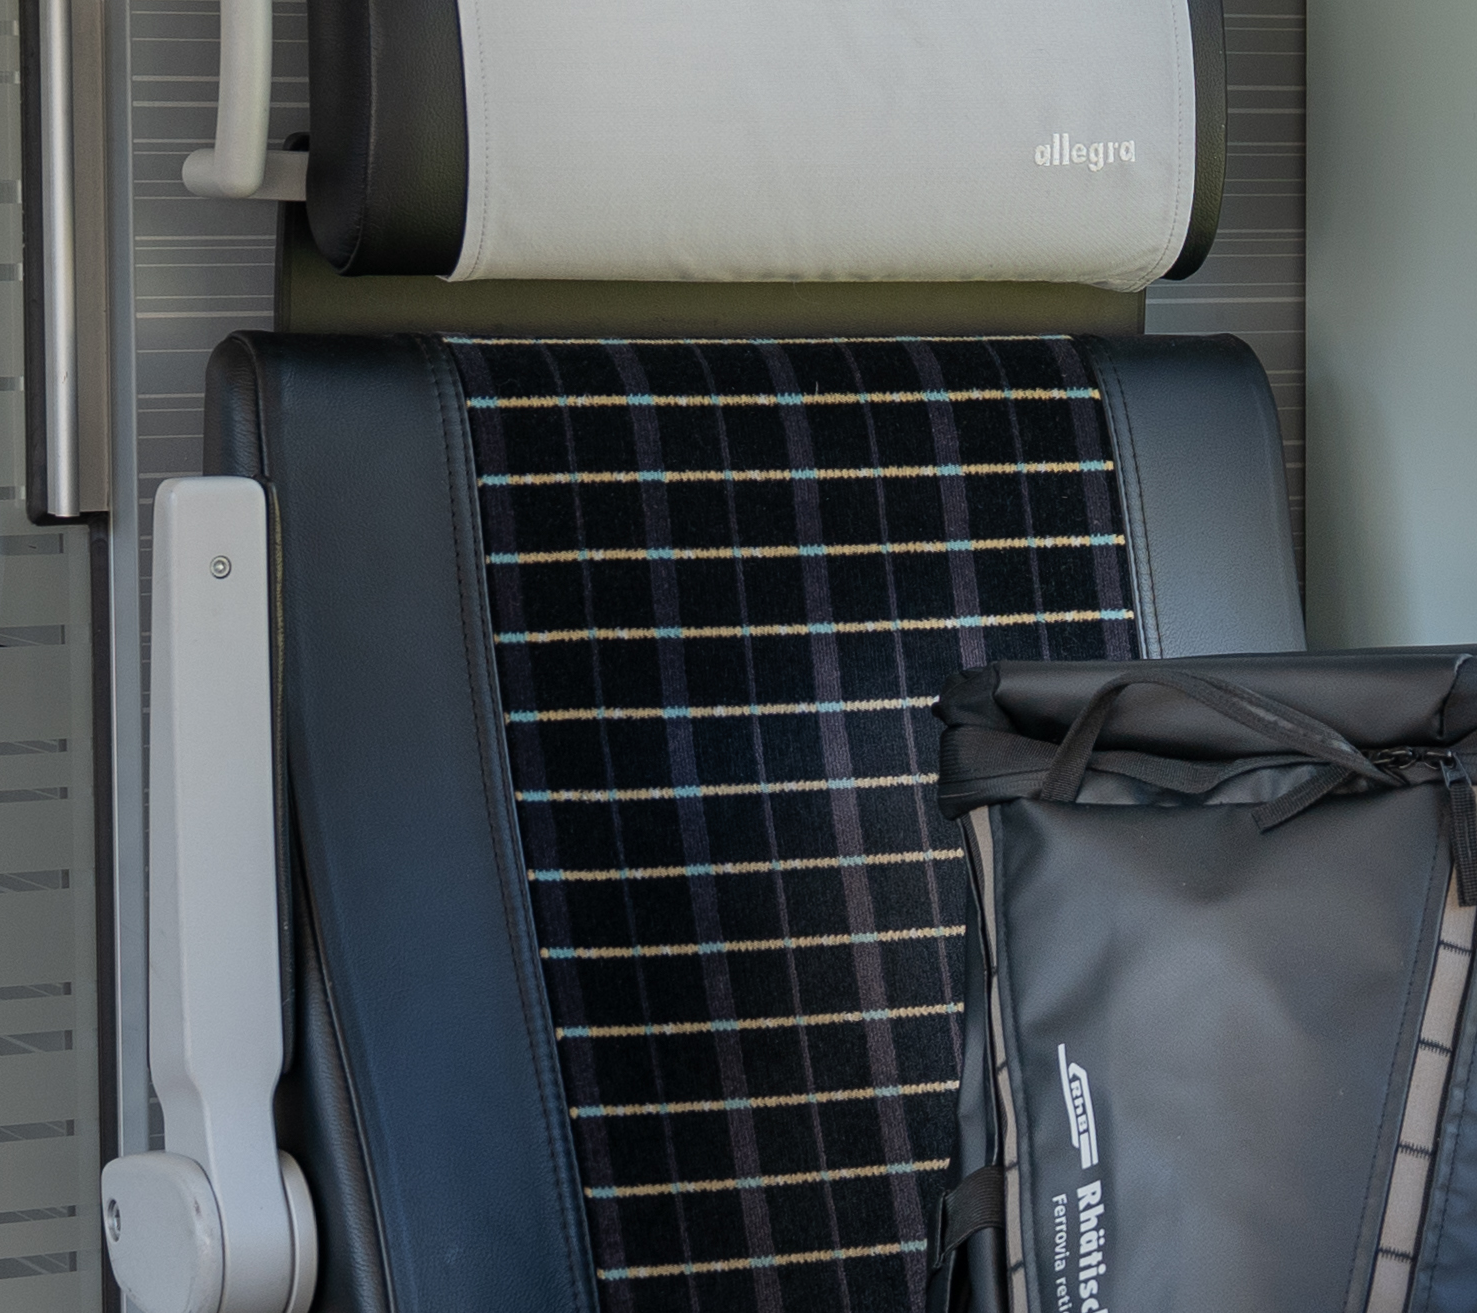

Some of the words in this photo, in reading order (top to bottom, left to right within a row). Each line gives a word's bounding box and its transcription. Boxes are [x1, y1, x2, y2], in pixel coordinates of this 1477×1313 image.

[1034, 133, 1136, 172] allegra
[1070, 1079, 1089, 1133] RhB
[1052, 1193, 1070, 1272] Ferrovia
